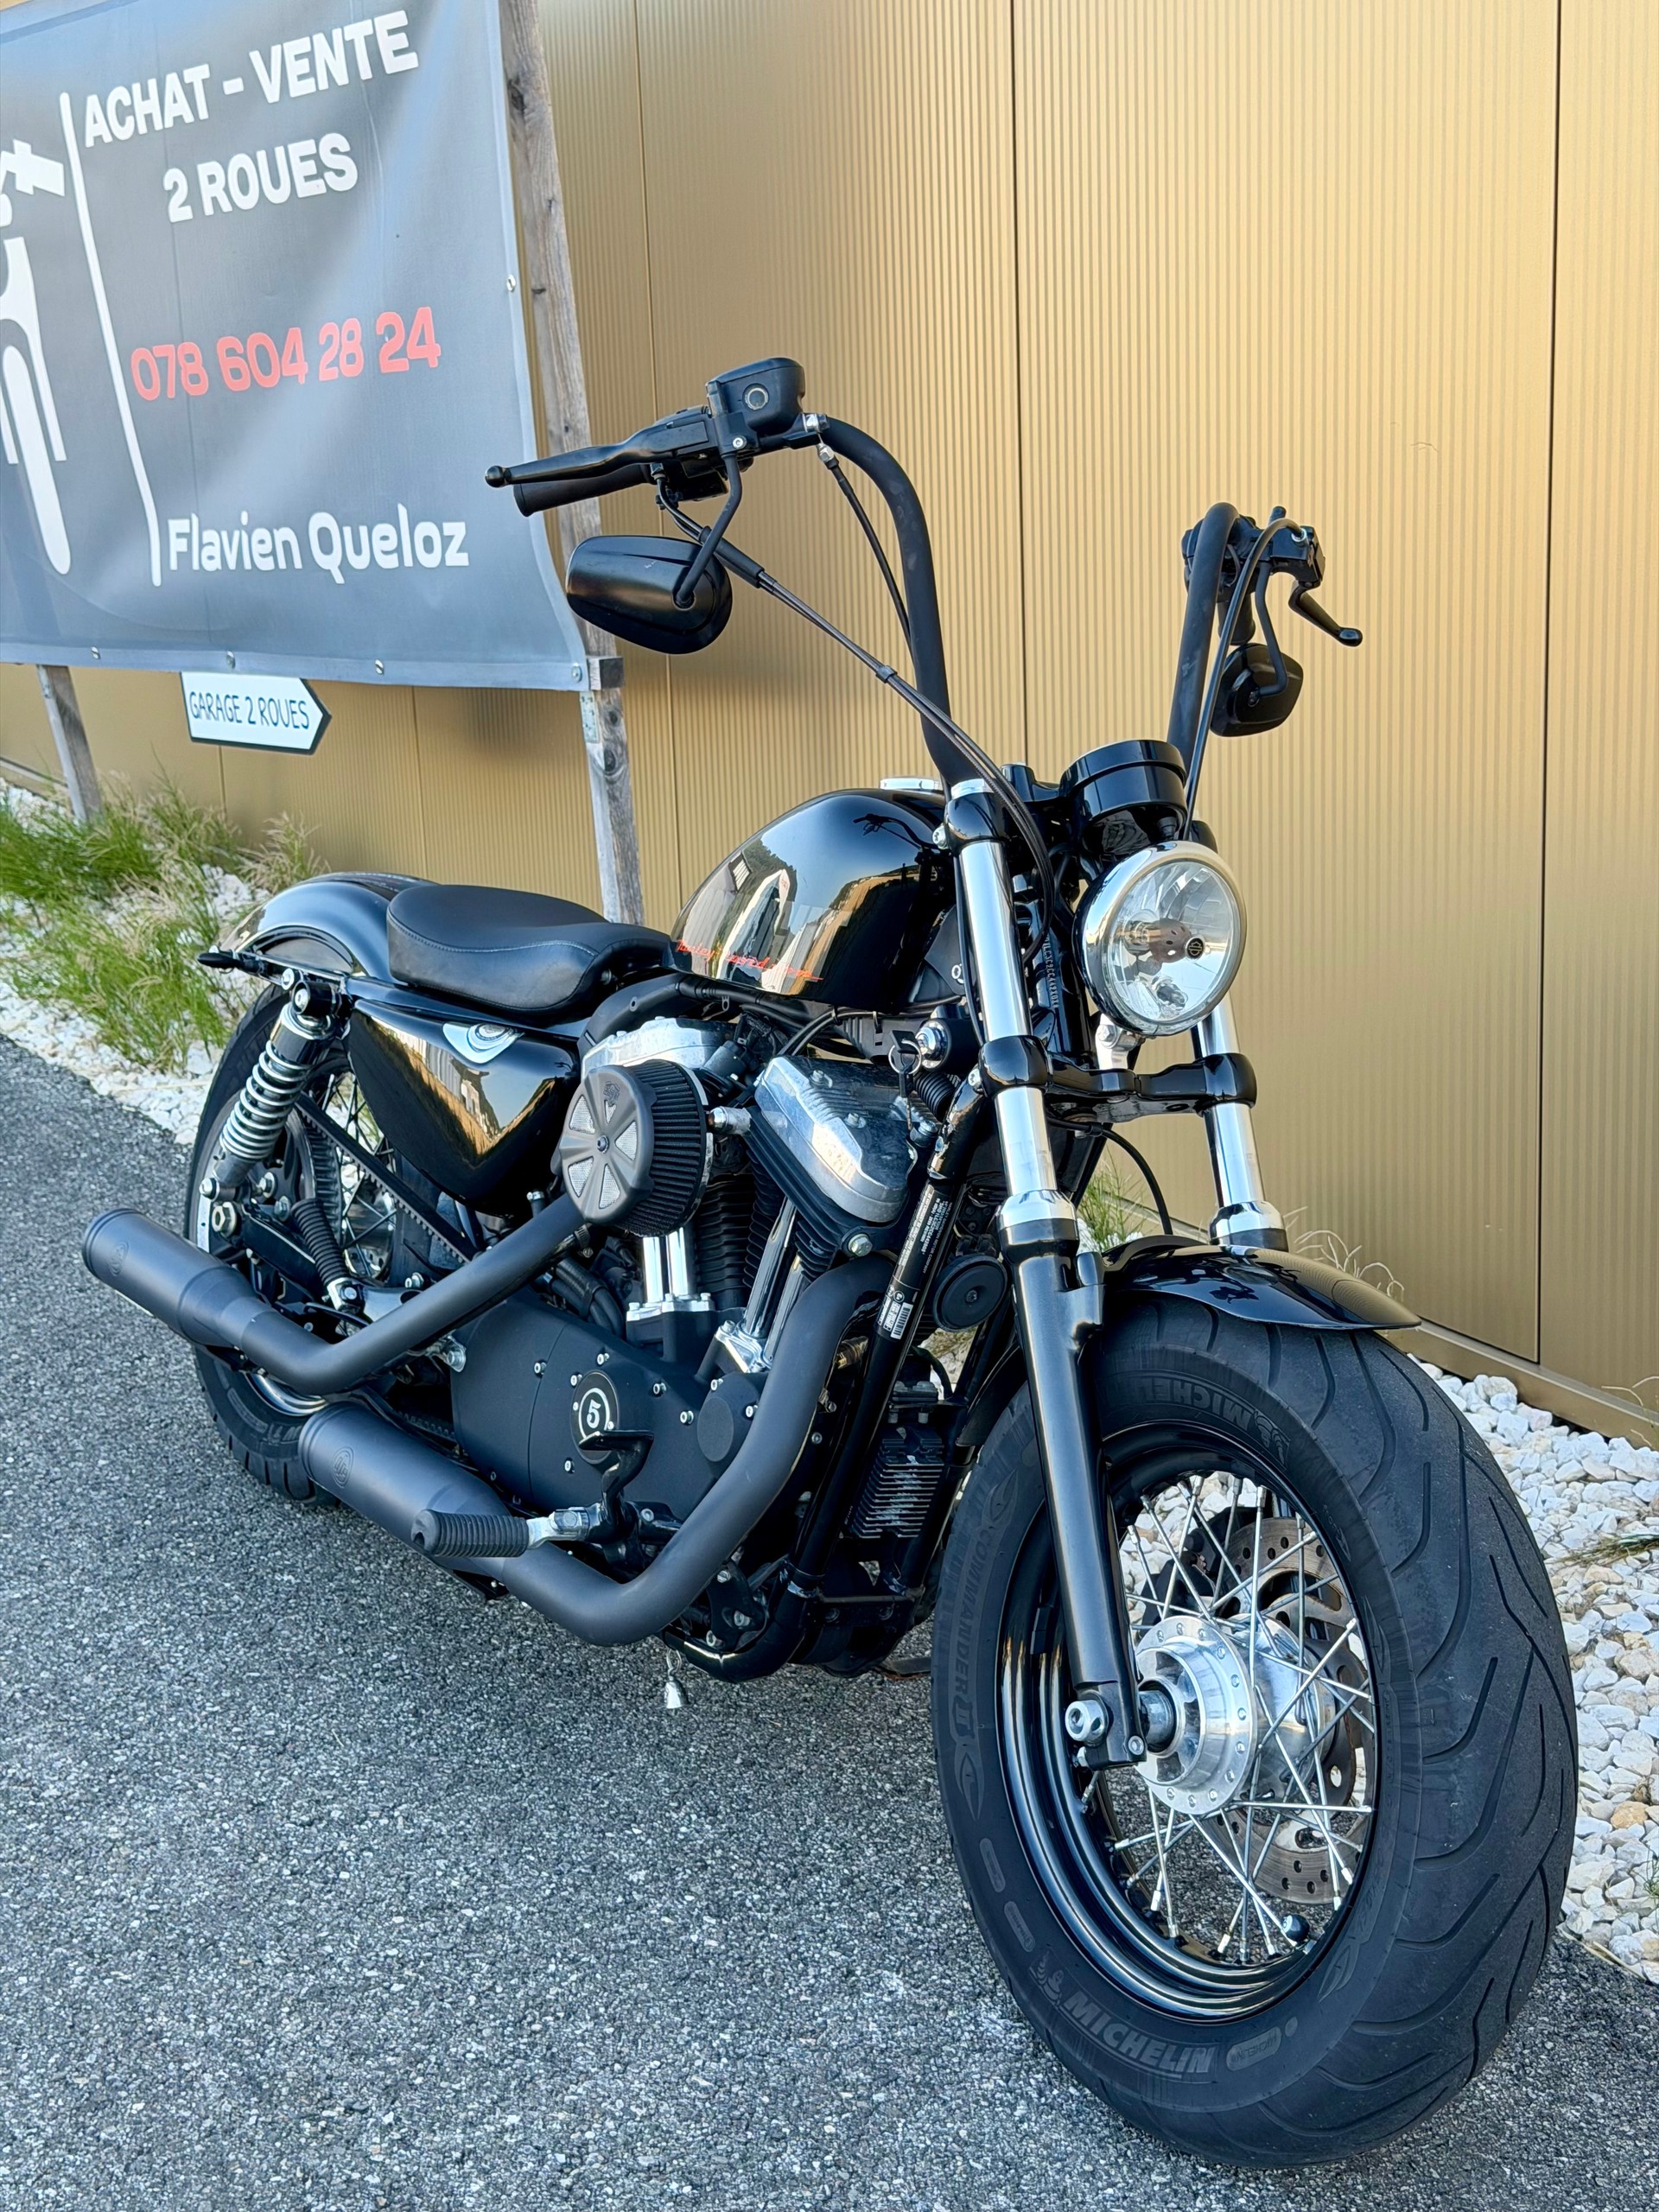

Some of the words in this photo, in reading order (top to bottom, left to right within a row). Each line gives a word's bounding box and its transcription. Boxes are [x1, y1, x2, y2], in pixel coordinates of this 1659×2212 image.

[85, 64, 210, 148] ACHAT
[249, 10, 419, 104] VENTE
[162, 168, 194, 223] 2
[197, 133, 359, 216] ROUES
[130, 342, 209, 400] 078
[216, 327, 308, 391] 604
[318, 318, 364, 381] 28
[376, 307, 442, 373] 24
[168, 511, 302, 571] Flavien
[308, 503, 470, 584] Queloz
[189, 691, 243, 724] GARAGE
[245, 696, 256, 725] 2
[258, 696, 310, 730] ROUES
[586, 1399, 602, 1429] 5
[955, 1529, 992, 1696] COMMANDER
[1063, 1991, 1215, 2075] MICHELIN
